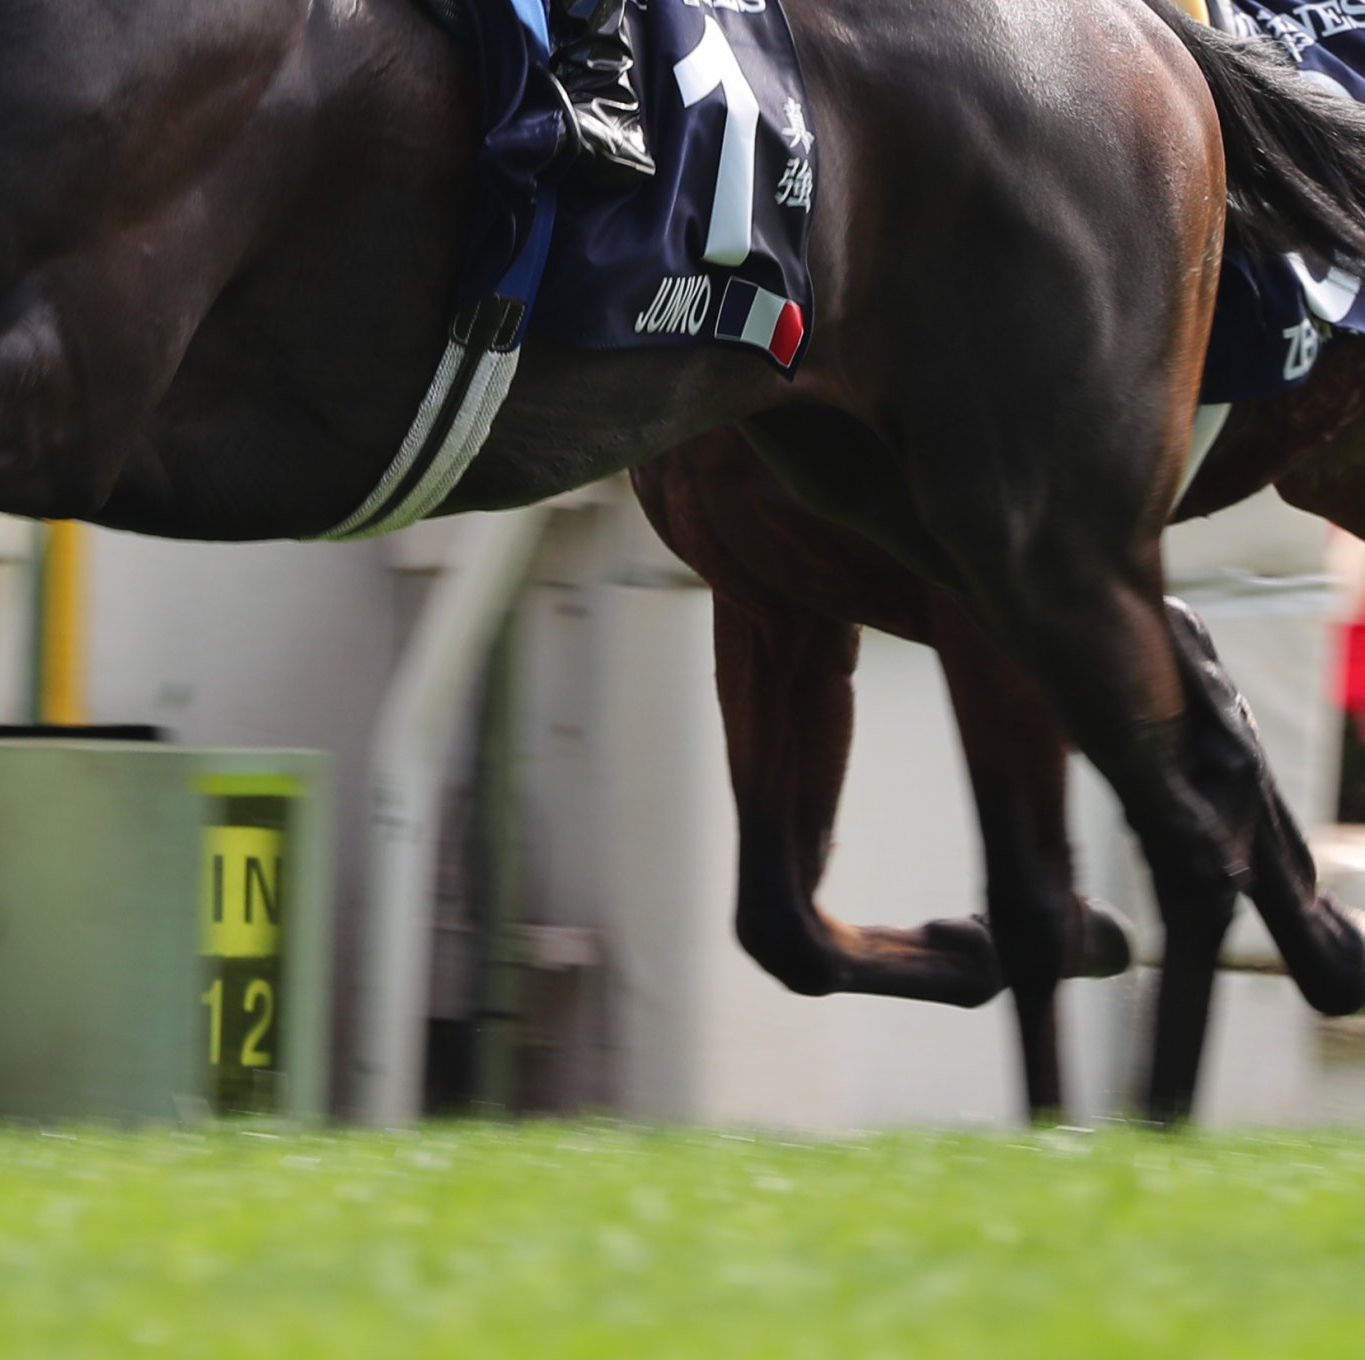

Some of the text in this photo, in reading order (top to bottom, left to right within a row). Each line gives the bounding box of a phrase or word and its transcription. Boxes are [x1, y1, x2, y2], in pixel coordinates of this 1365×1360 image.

[674, 15, 760, 267] 1
[635, 273, 712, 337] JUNKO
[200, 977, 276, 1068] 12
